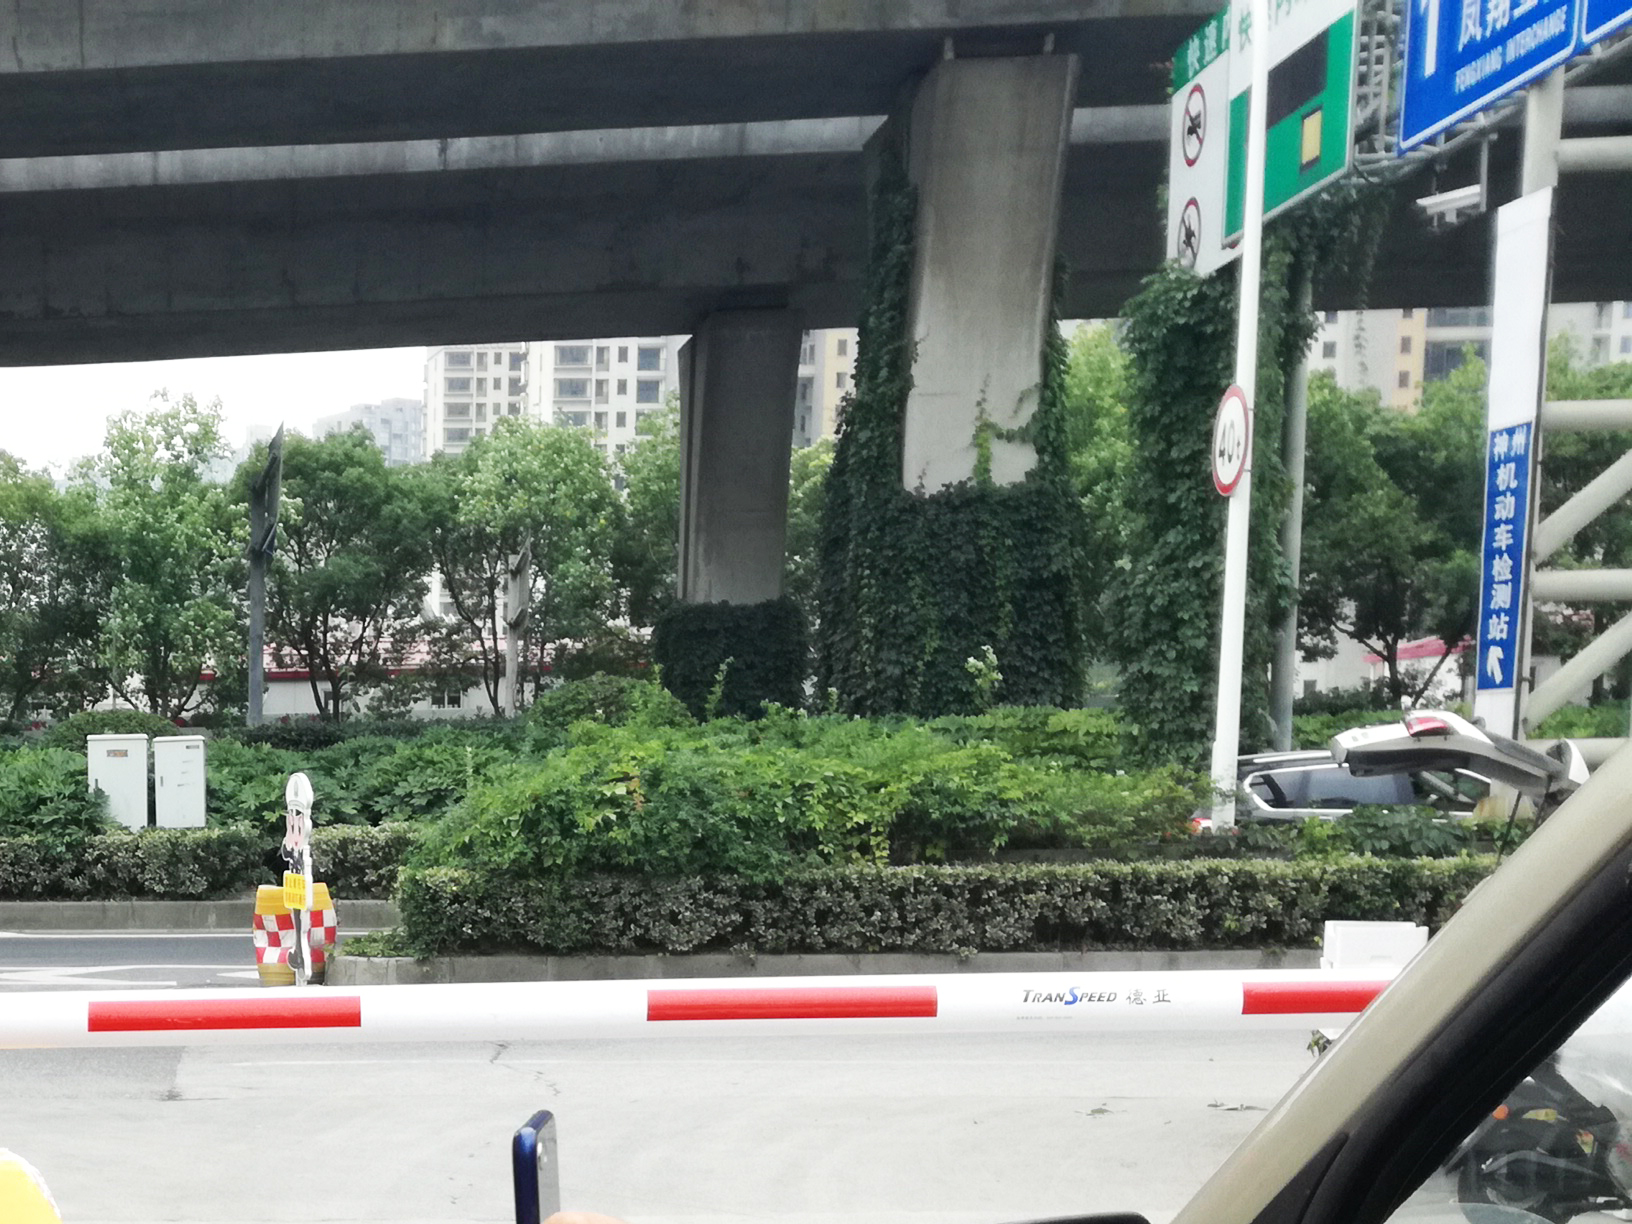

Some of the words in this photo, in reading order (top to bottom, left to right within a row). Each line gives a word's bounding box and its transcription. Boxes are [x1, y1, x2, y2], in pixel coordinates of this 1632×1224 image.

[1487, 462, 1518, 641] 机动车检测站
